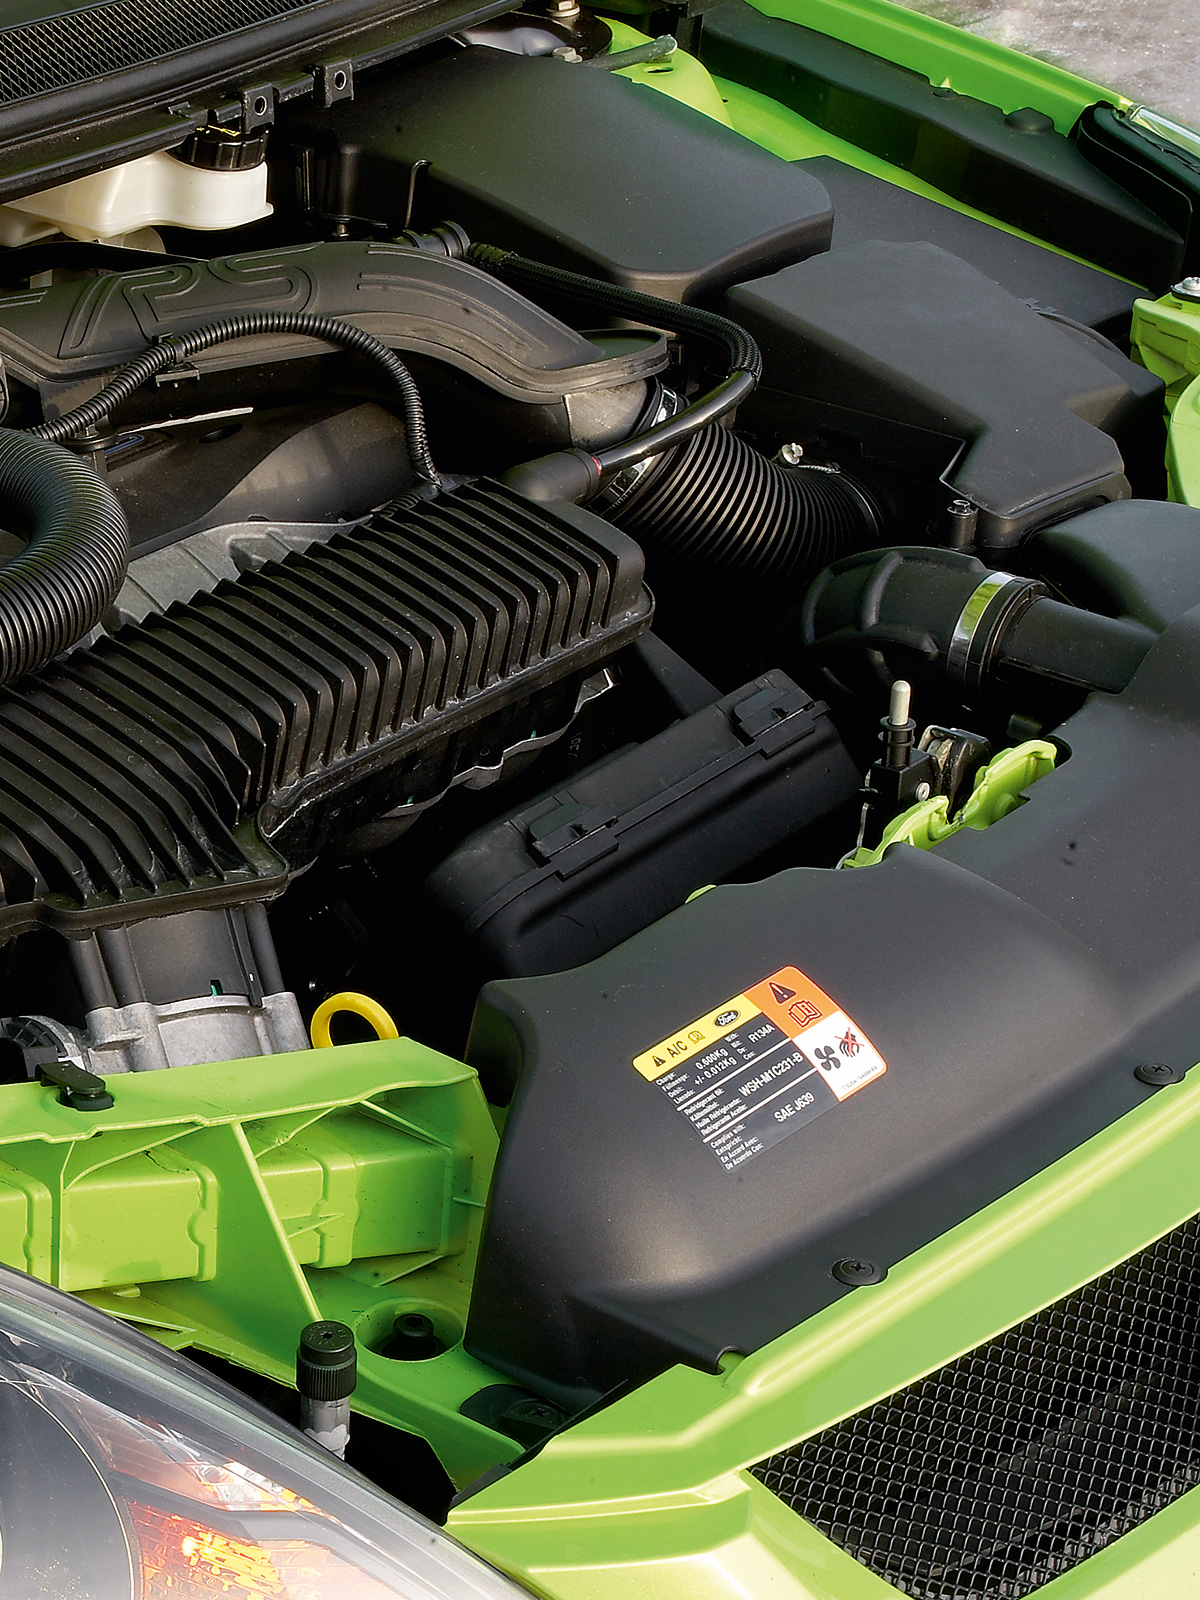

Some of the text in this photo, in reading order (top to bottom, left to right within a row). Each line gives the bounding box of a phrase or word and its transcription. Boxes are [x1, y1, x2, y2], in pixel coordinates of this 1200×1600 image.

[666, 1010, 739, 1058] A/C Ford
[747, 1023, 776, 1043] R134A
[695, 1048, 729, 1070] 0.600Kg
[704, 1056, 738, 1079] 0.012Kg
[655, 1072, 677, 1087] Charge:
[738, 1051, 805, 1097] WSH-M1C231-B
[773, 1091, 816, 1123] SAE J639
